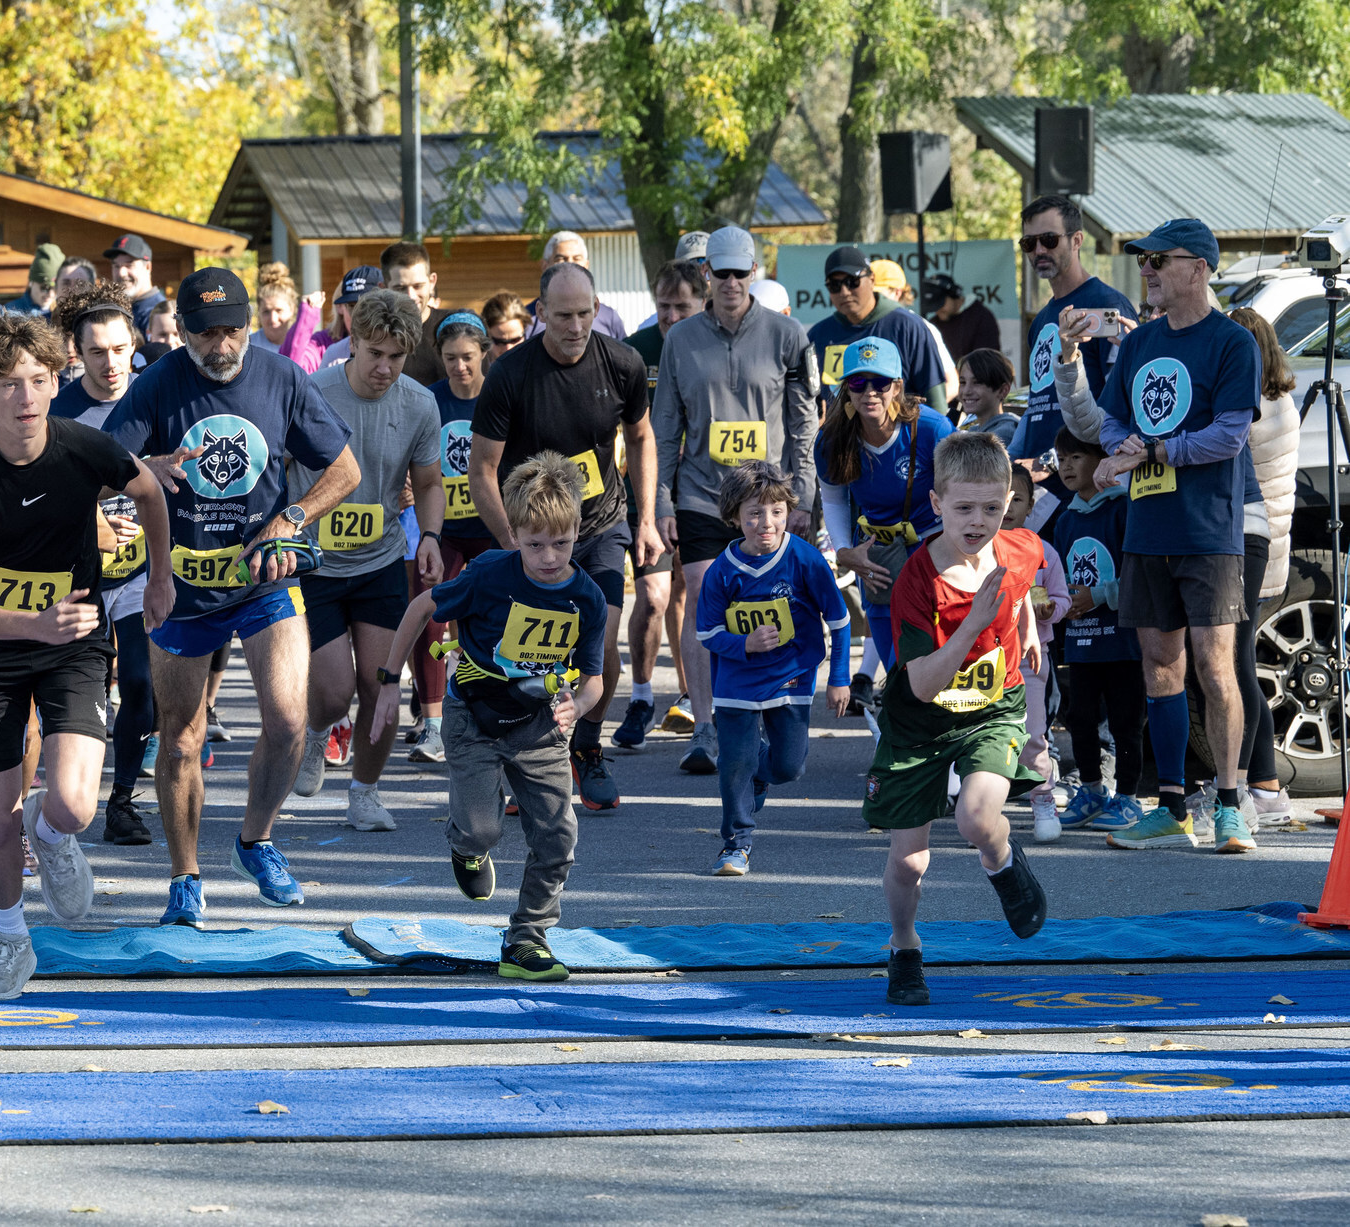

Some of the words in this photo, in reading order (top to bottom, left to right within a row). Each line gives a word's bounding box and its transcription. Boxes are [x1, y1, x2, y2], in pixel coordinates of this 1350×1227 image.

[720, 429, 757, 453] 754
[1144, 483, 1162, 493] TIMING
[176, 508, 218, 523] PANDAS
[219, 512, 248, 525] PANS
[194, 502, 246, 514] VERMONT
[203, 523, 236, 532] 2025
[330, 511, 374, 538] 620
[182, 556, 233, 581] 597
[735, 608, 782, 635] 603
[518, 616, 573, 649] 711
[519, 651, 535, 660] 802
[536, 652, 563, 661] TIMING
[942, 700, 958, 708] 802
[960, 698, 989, 708] TIMING
